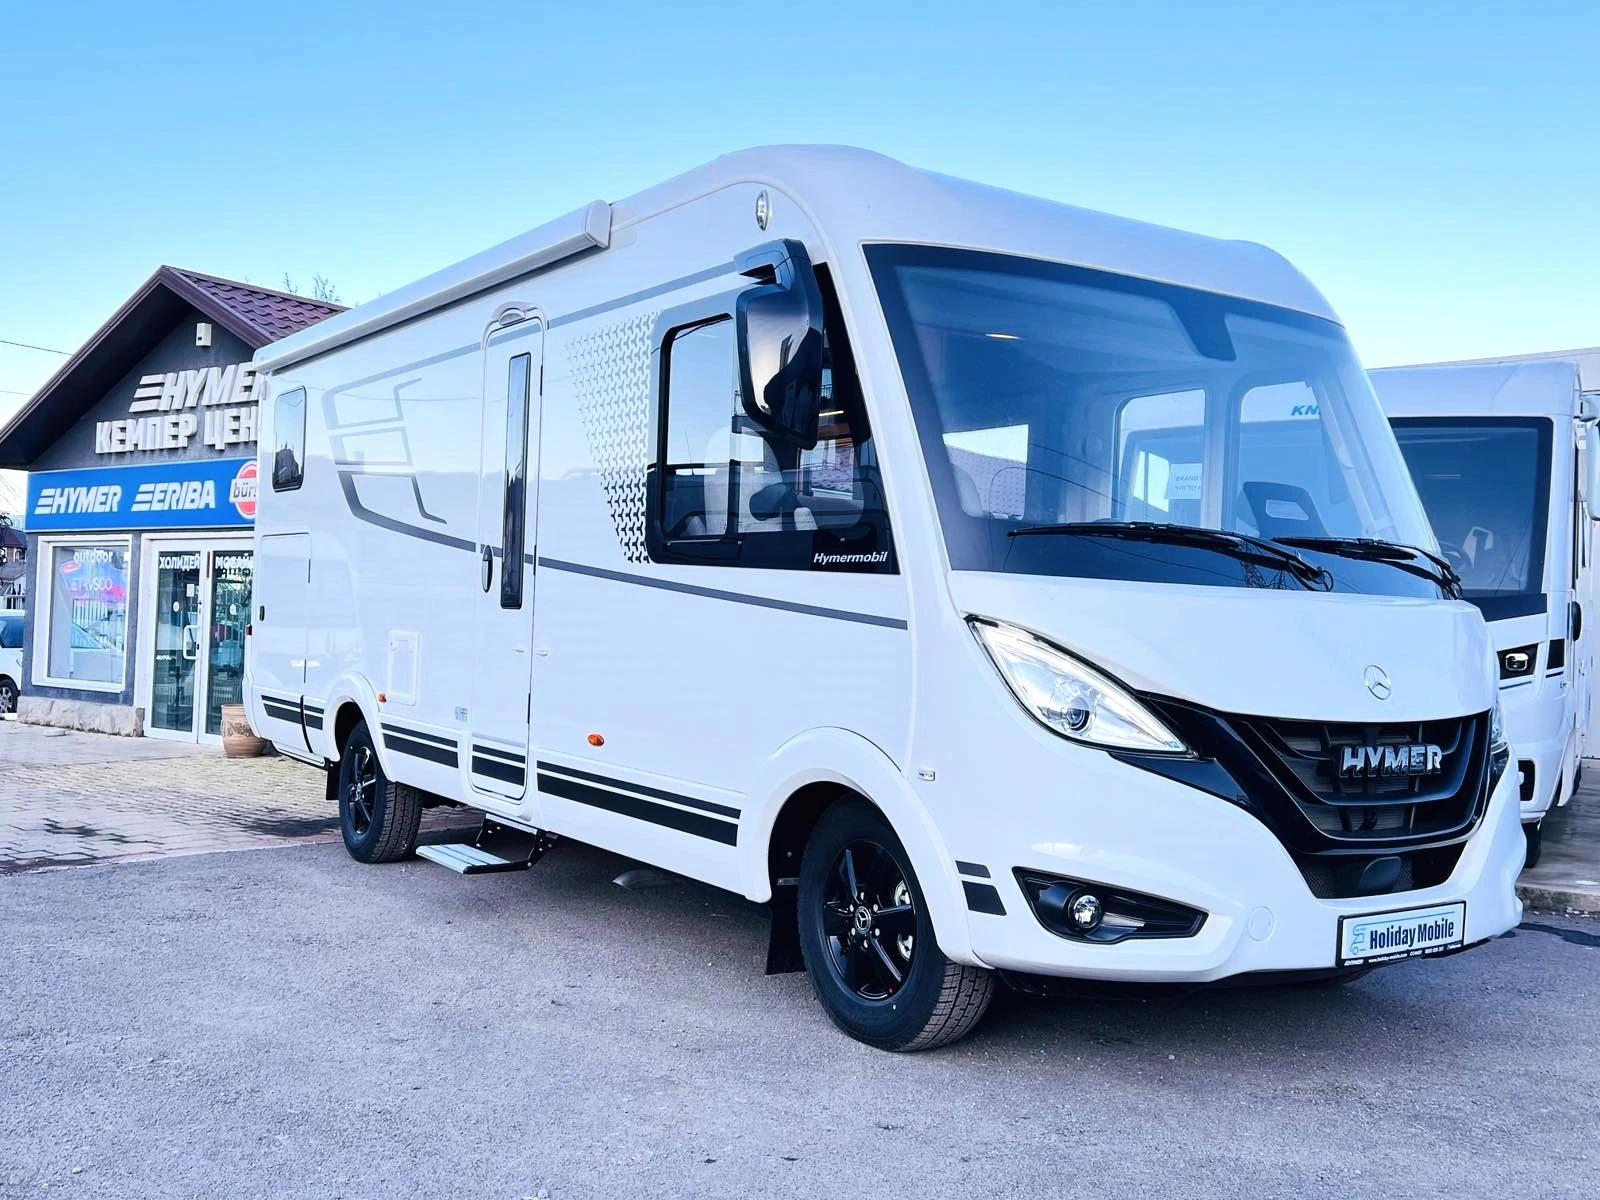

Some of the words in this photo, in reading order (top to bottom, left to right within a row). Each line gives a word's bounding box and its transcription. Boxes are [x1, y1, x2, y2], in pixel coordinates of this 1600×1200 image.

[95, 413, 198, 454] КЕМПЕР
[50, 485, 122, 513] HYMER
[150, 480, 215, 511] ERIBA
[73, 548, 113, 562] outdoor
[159, 554, 200, 571] ХОЛИДЕЙ
[813, 551, 888, 566] Hymermobil
[1339, 744, 1443, 778] HYMER
[1369, 924, 1416, 950] Holiday
[1417, 917, 1455, 943] Mobile
